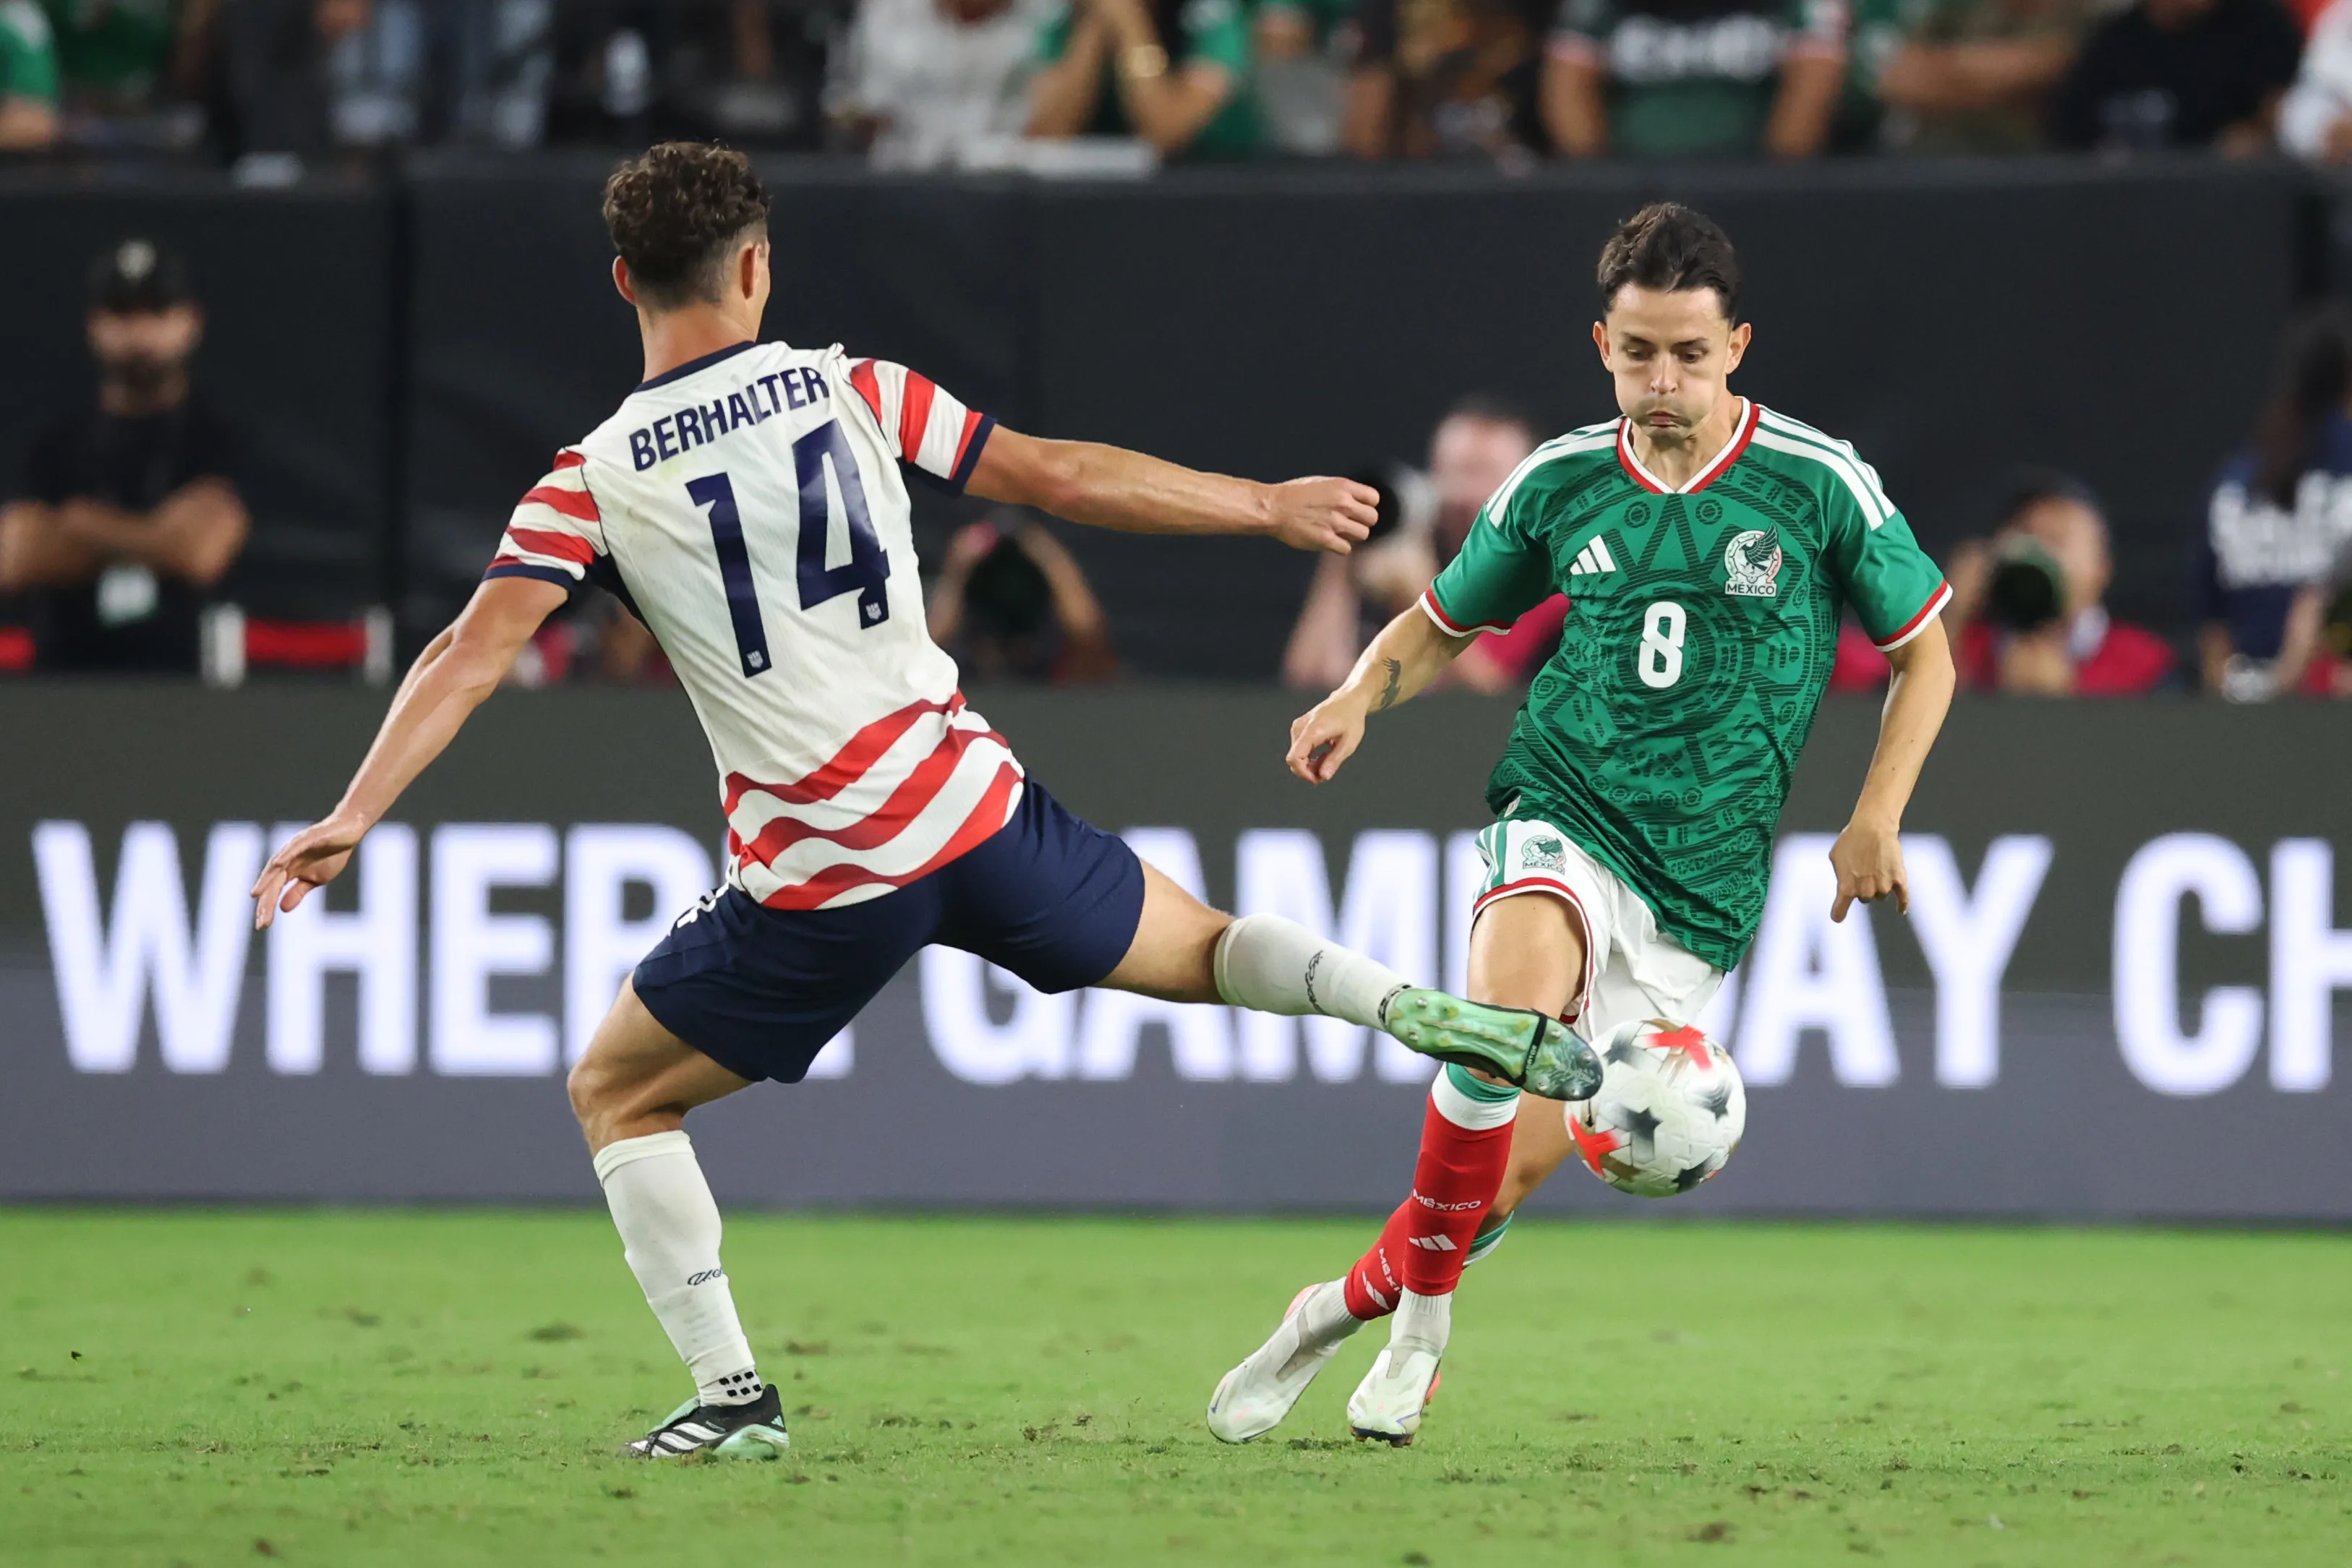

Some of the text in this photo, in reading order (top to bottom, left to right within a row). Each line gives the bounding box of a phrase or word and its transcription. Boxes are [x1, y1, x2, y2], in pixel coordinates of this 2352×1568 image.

[628, 367, 830, 472] BERHALTER
[685, 417, 891, 679] 14
[1726, 581, 1775, 595] MÉXICO
[1638, 601, 1687, 689] 8
[31, 819, 855, 1078] WHER
